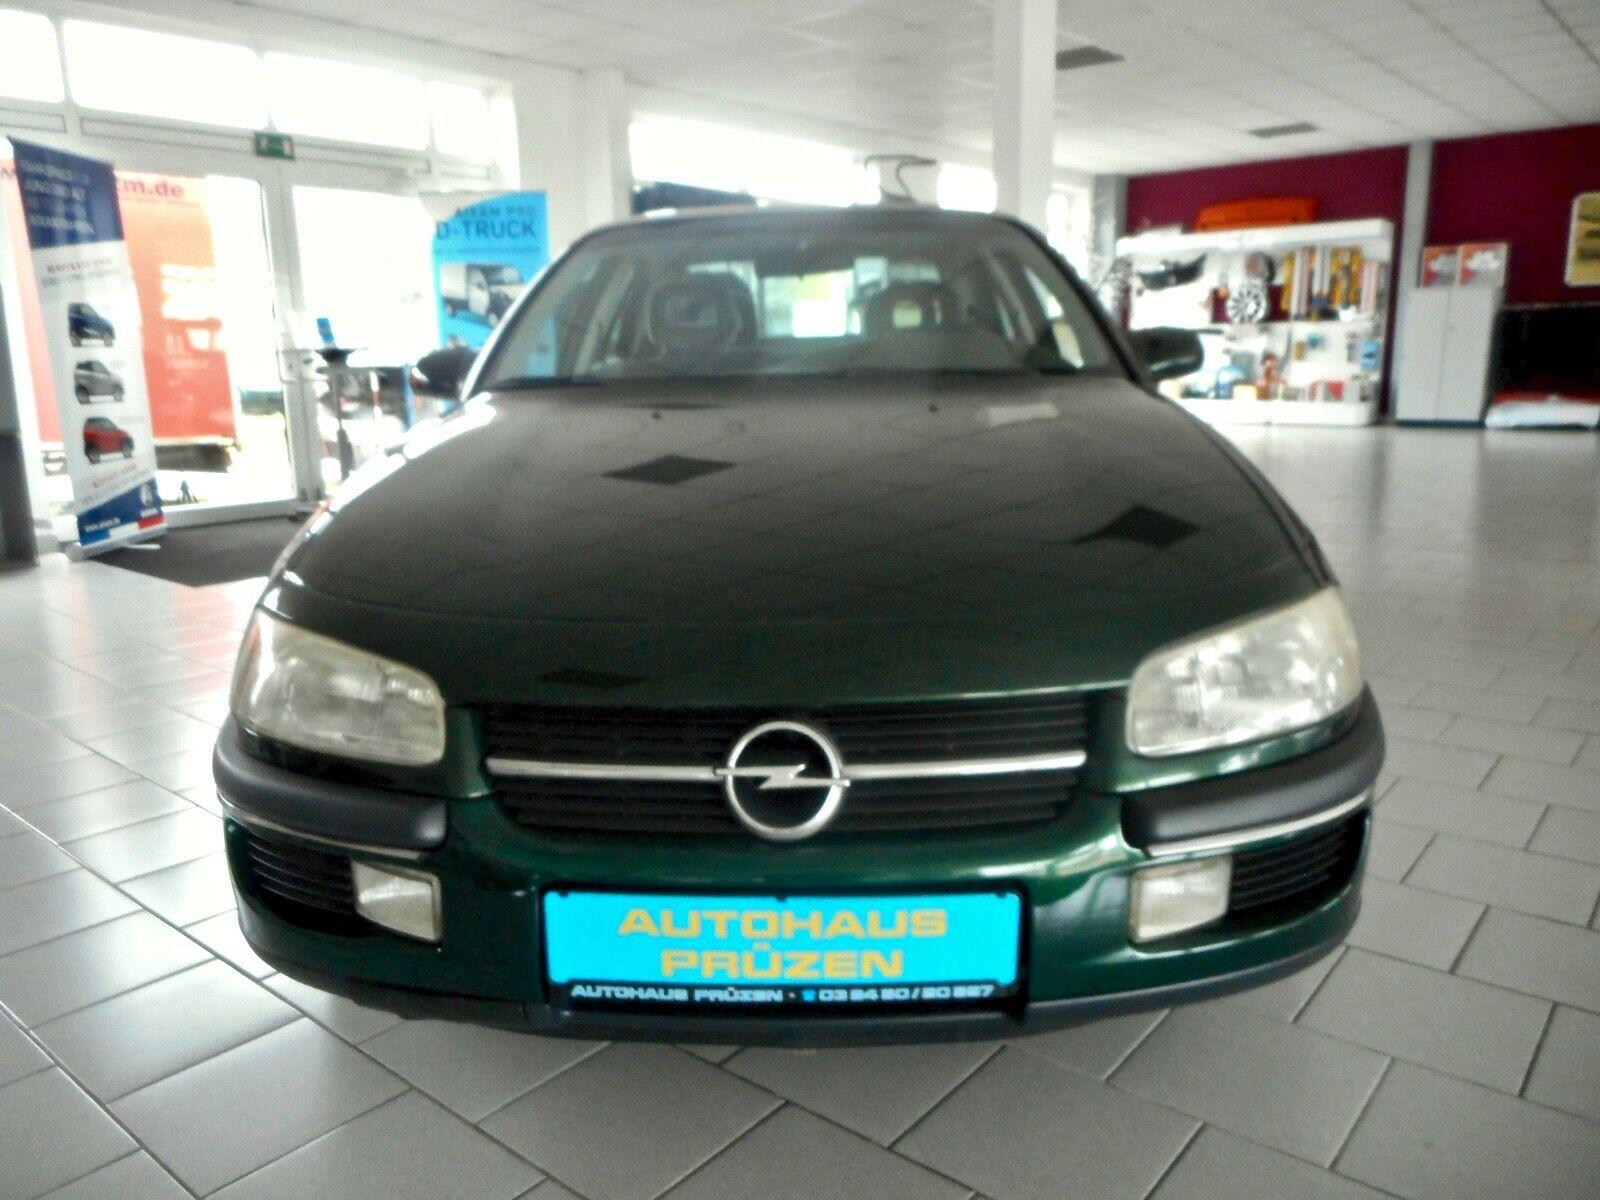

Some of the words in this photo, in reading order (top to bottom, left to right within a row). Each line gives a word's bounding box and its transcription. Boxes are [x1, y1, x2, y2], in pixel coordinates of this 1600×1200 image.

[618, 907, 948, 939] AUTOHAUS
[661, 941, 904, 979] PRÜZEN
[571, 984, 689, 1000] AUTOHAUS
[694, 986, 784, 1002] PRÜZEN
